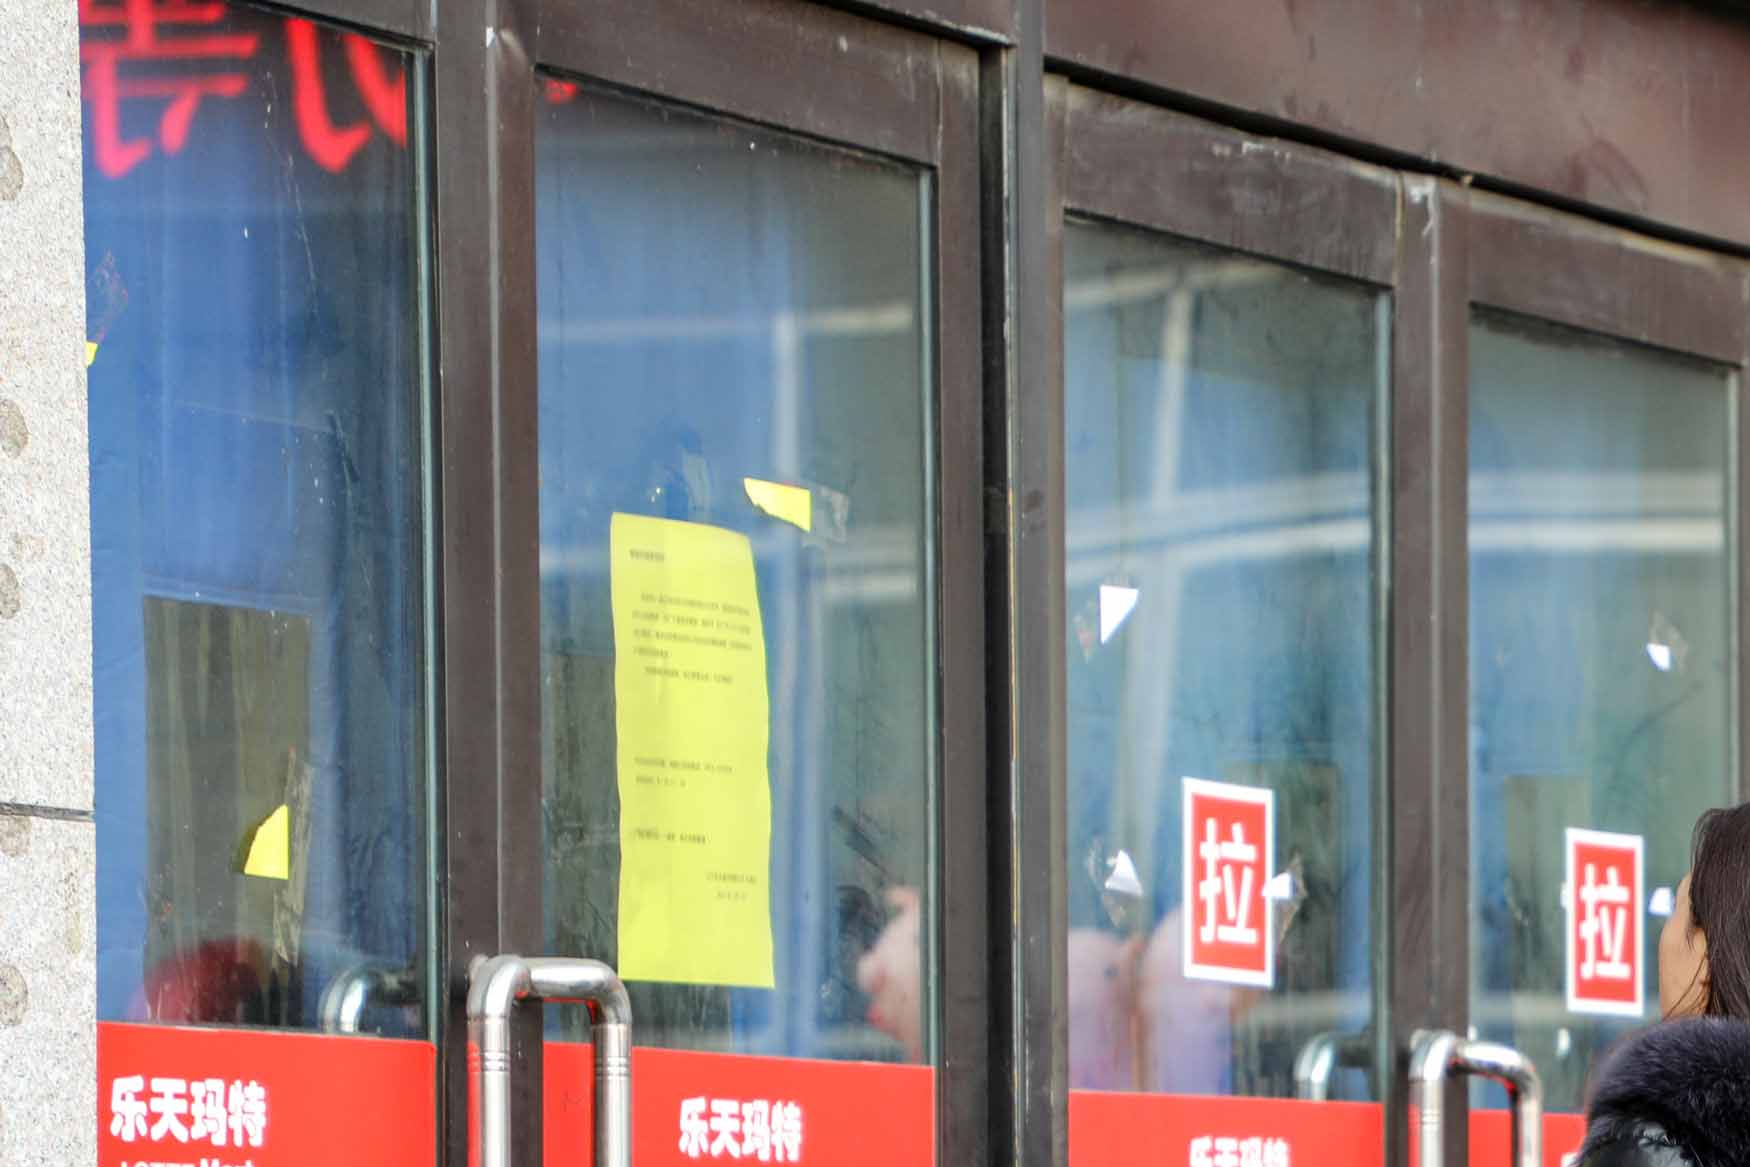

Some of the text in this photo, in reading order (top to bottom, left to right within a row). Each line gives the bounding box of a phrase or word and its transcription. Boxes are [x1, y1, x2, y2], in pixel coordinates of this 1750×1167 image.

[1199, 816, 1258, 945] 拉
[1579, 862, 1631, 981] 拉
[110, 1074, 266, 1148] 乐天玛特
[678, 1095, 803, 1162] 乐天玛特
